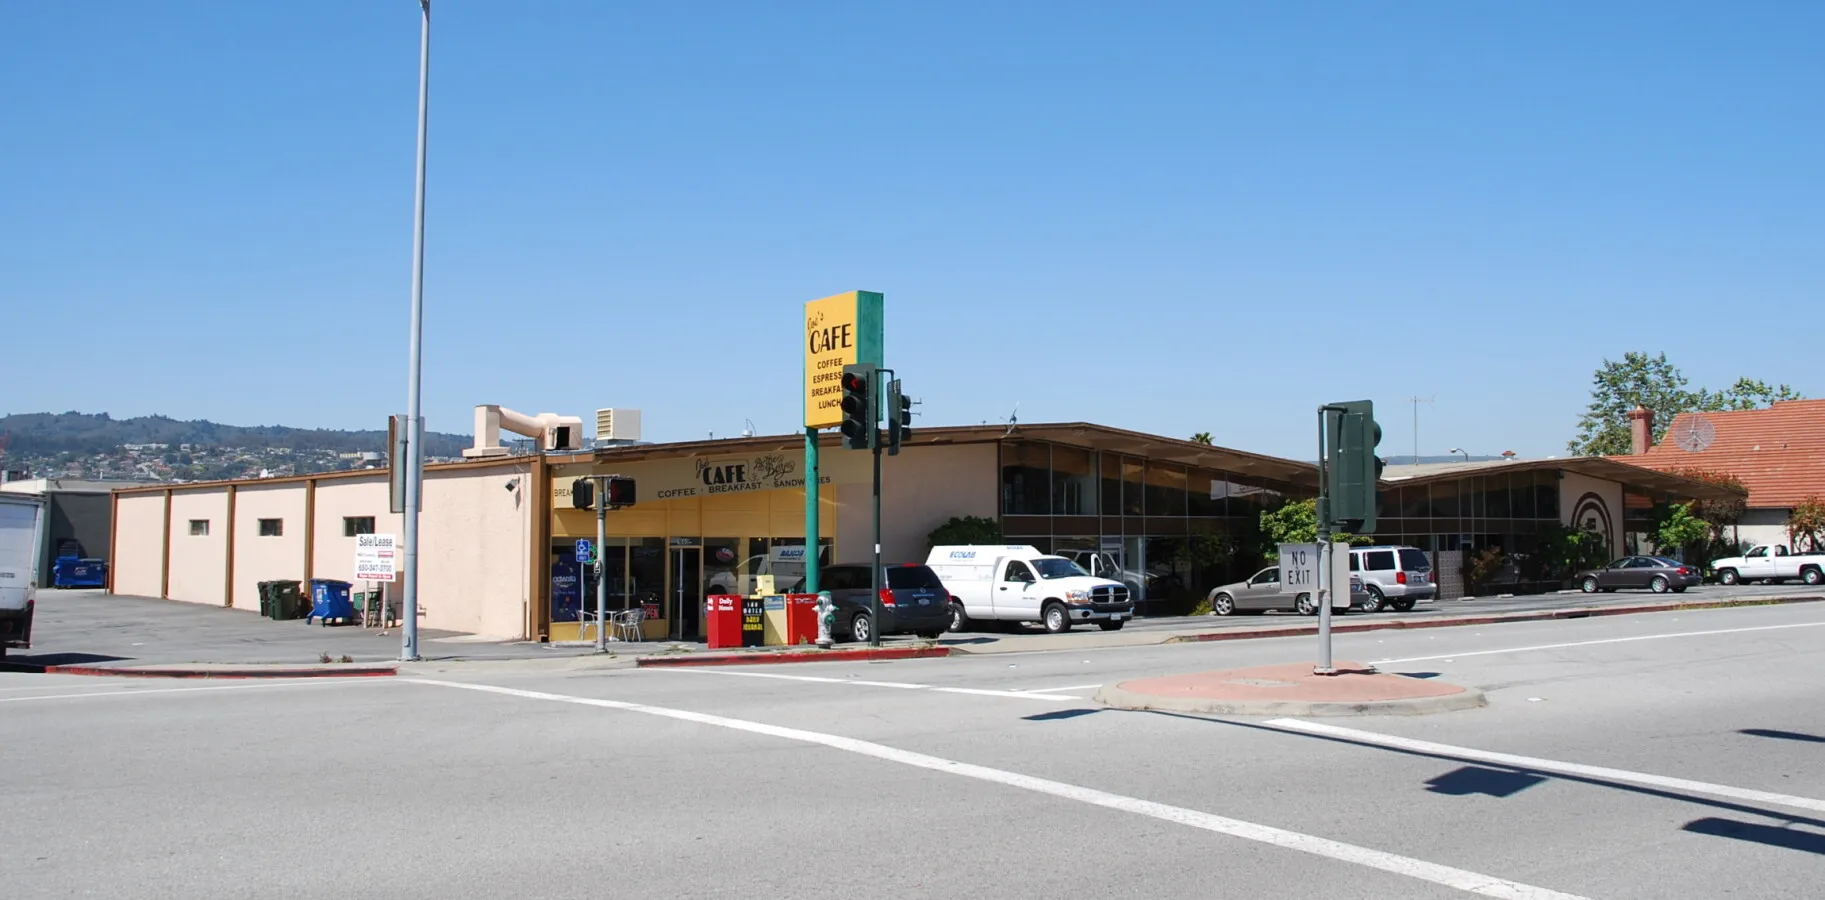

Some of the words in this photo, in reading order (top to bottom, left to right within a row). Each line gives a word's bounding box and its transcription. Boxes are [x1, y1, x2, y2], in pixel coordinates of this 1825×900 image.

[810, 323, 852, 355] CAFE
[817, 358, 843, 370] COFFEE
[813, 371, 842, 384] ESPRESS
[811, 384, 843, 397] BREAKFA
[818, 398, 842, 410] LUNCH
[702, 464, 746, 486] CAFE
[657, 487, 697, 498] COFFEE
[708, 481, 762, 494] BREAKFAST
[773, 476, 831, 488] SANDWES
[359, 536, 393, 547] Sale/Lease
[949, 551, 976, 559] ECOLAB
[1291, 550, 1306, 566] NO
[1288, 570, 1310, 585] EXIT
[718, 597, 733, 606] Daily
